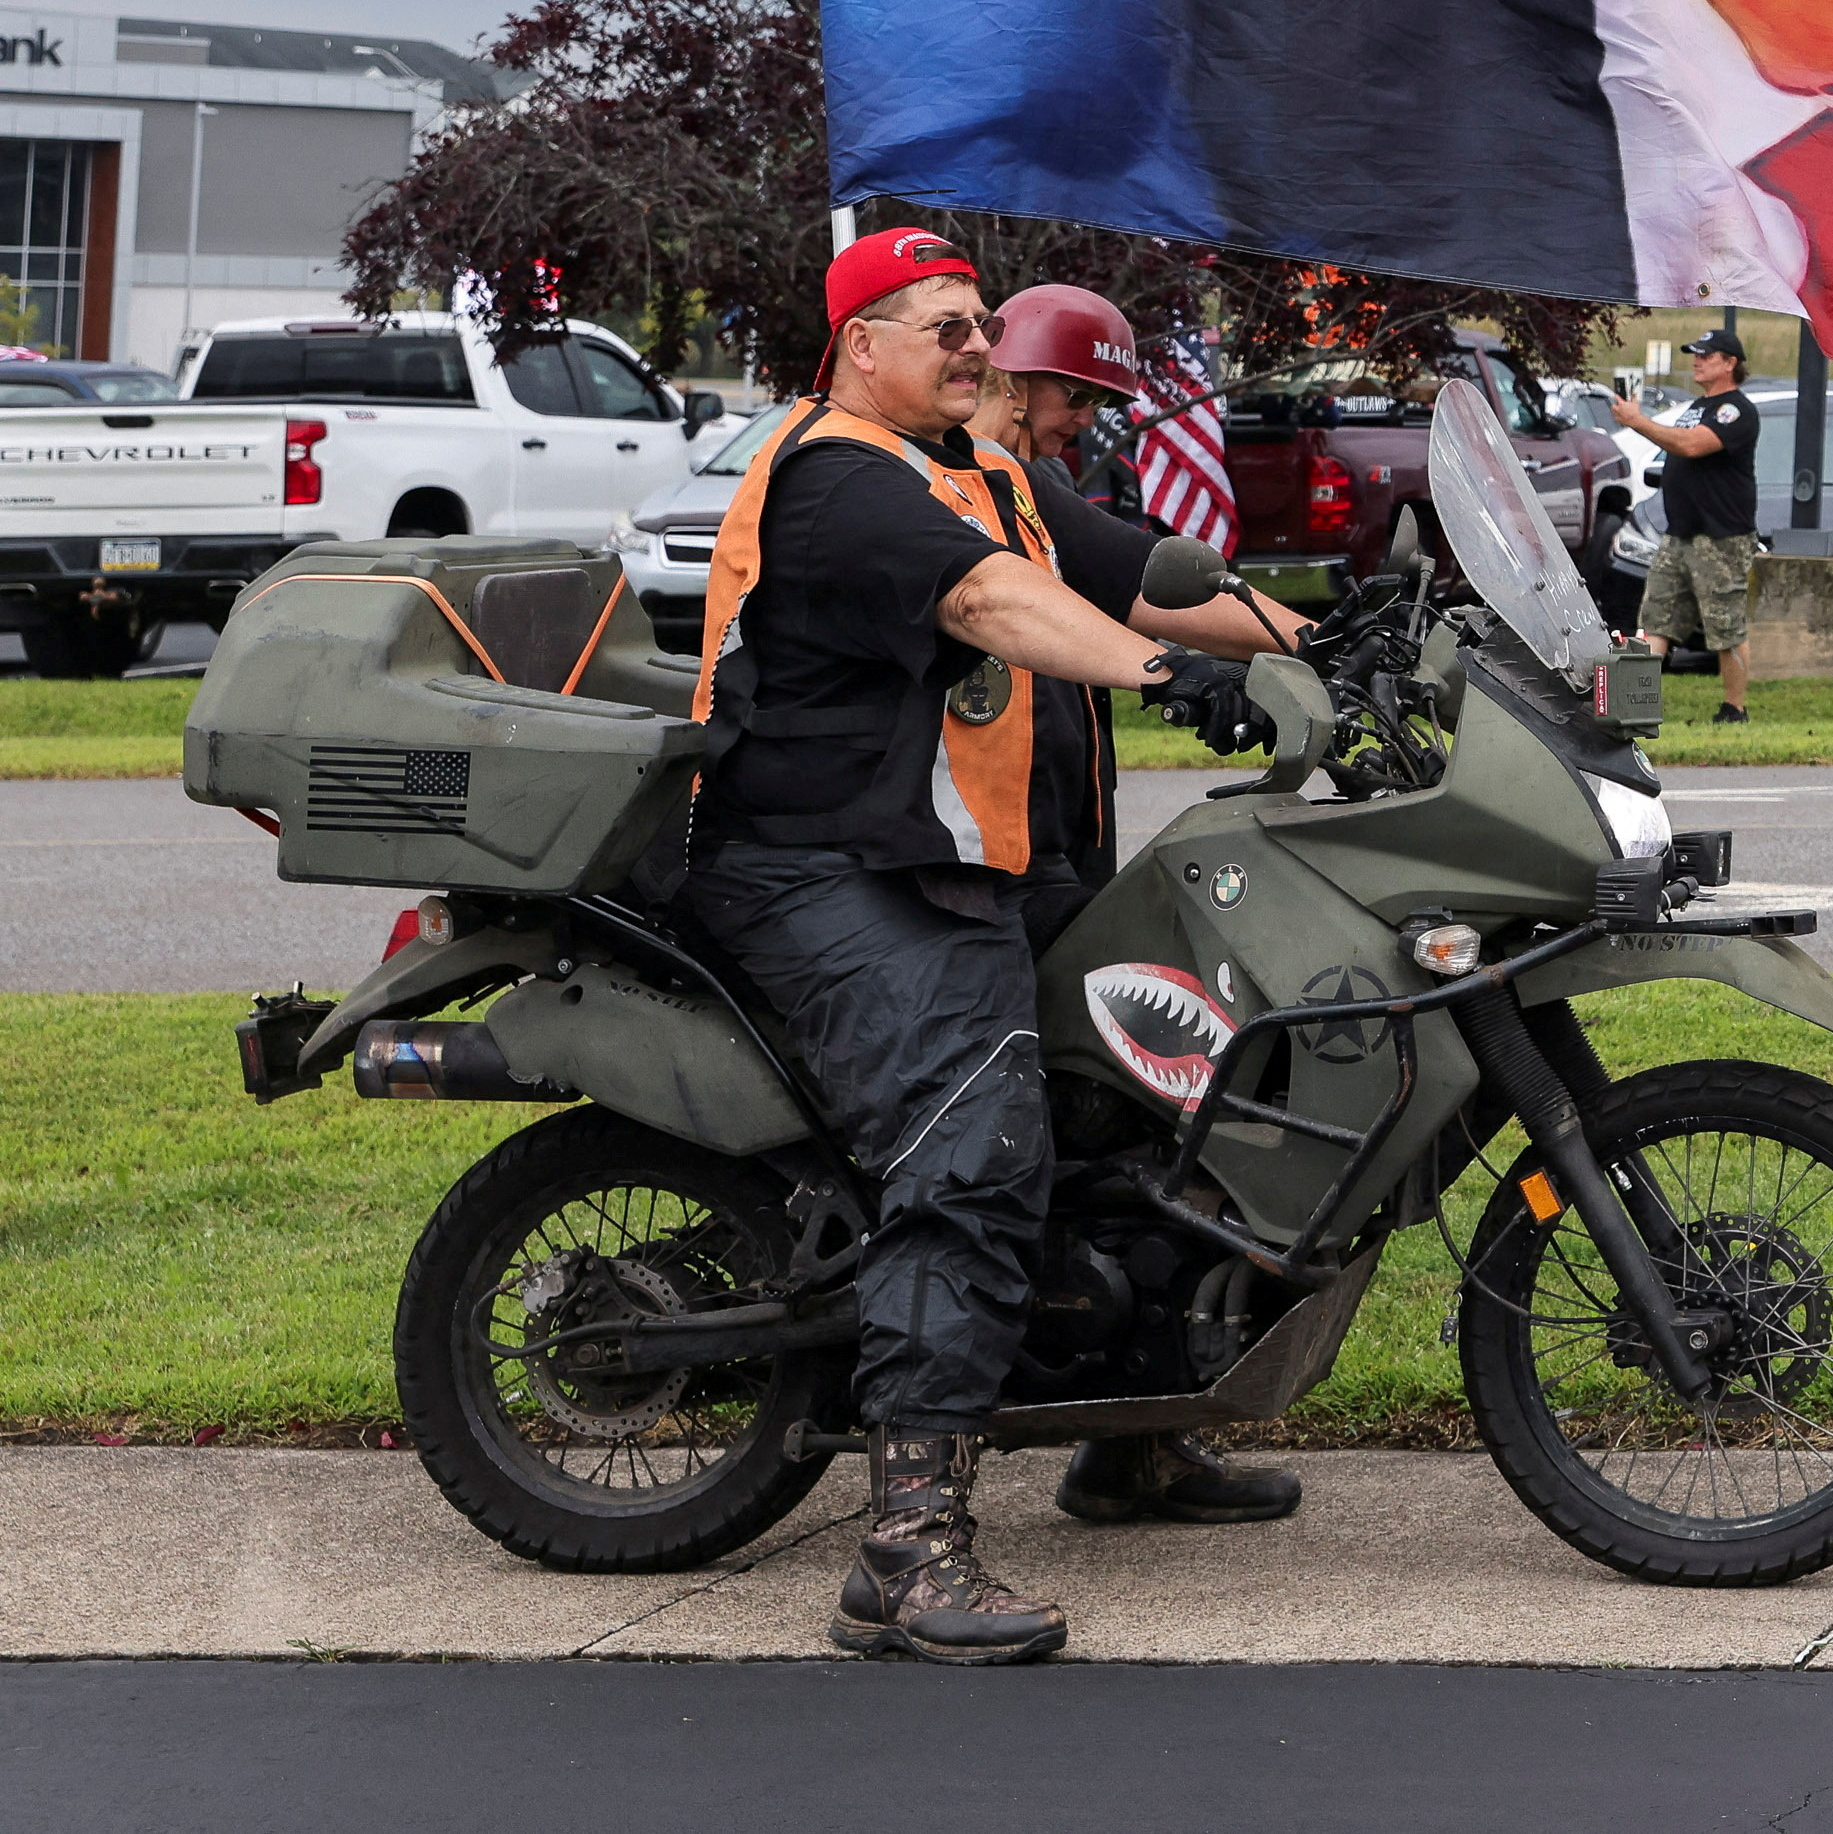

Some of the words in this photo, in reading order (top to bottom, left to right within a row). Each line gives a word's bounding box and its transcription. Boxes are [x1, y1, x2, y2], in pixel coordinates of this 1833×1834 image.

[1347, 395, 1388, 413] OUTLAWS
[0, 444, 259, 463] CHEVROLET
[1597, 670, 1605, 711] REPLICA
[1620, 935, 1653, 952] NO
[1660, 935, 1724, 952] STEP
